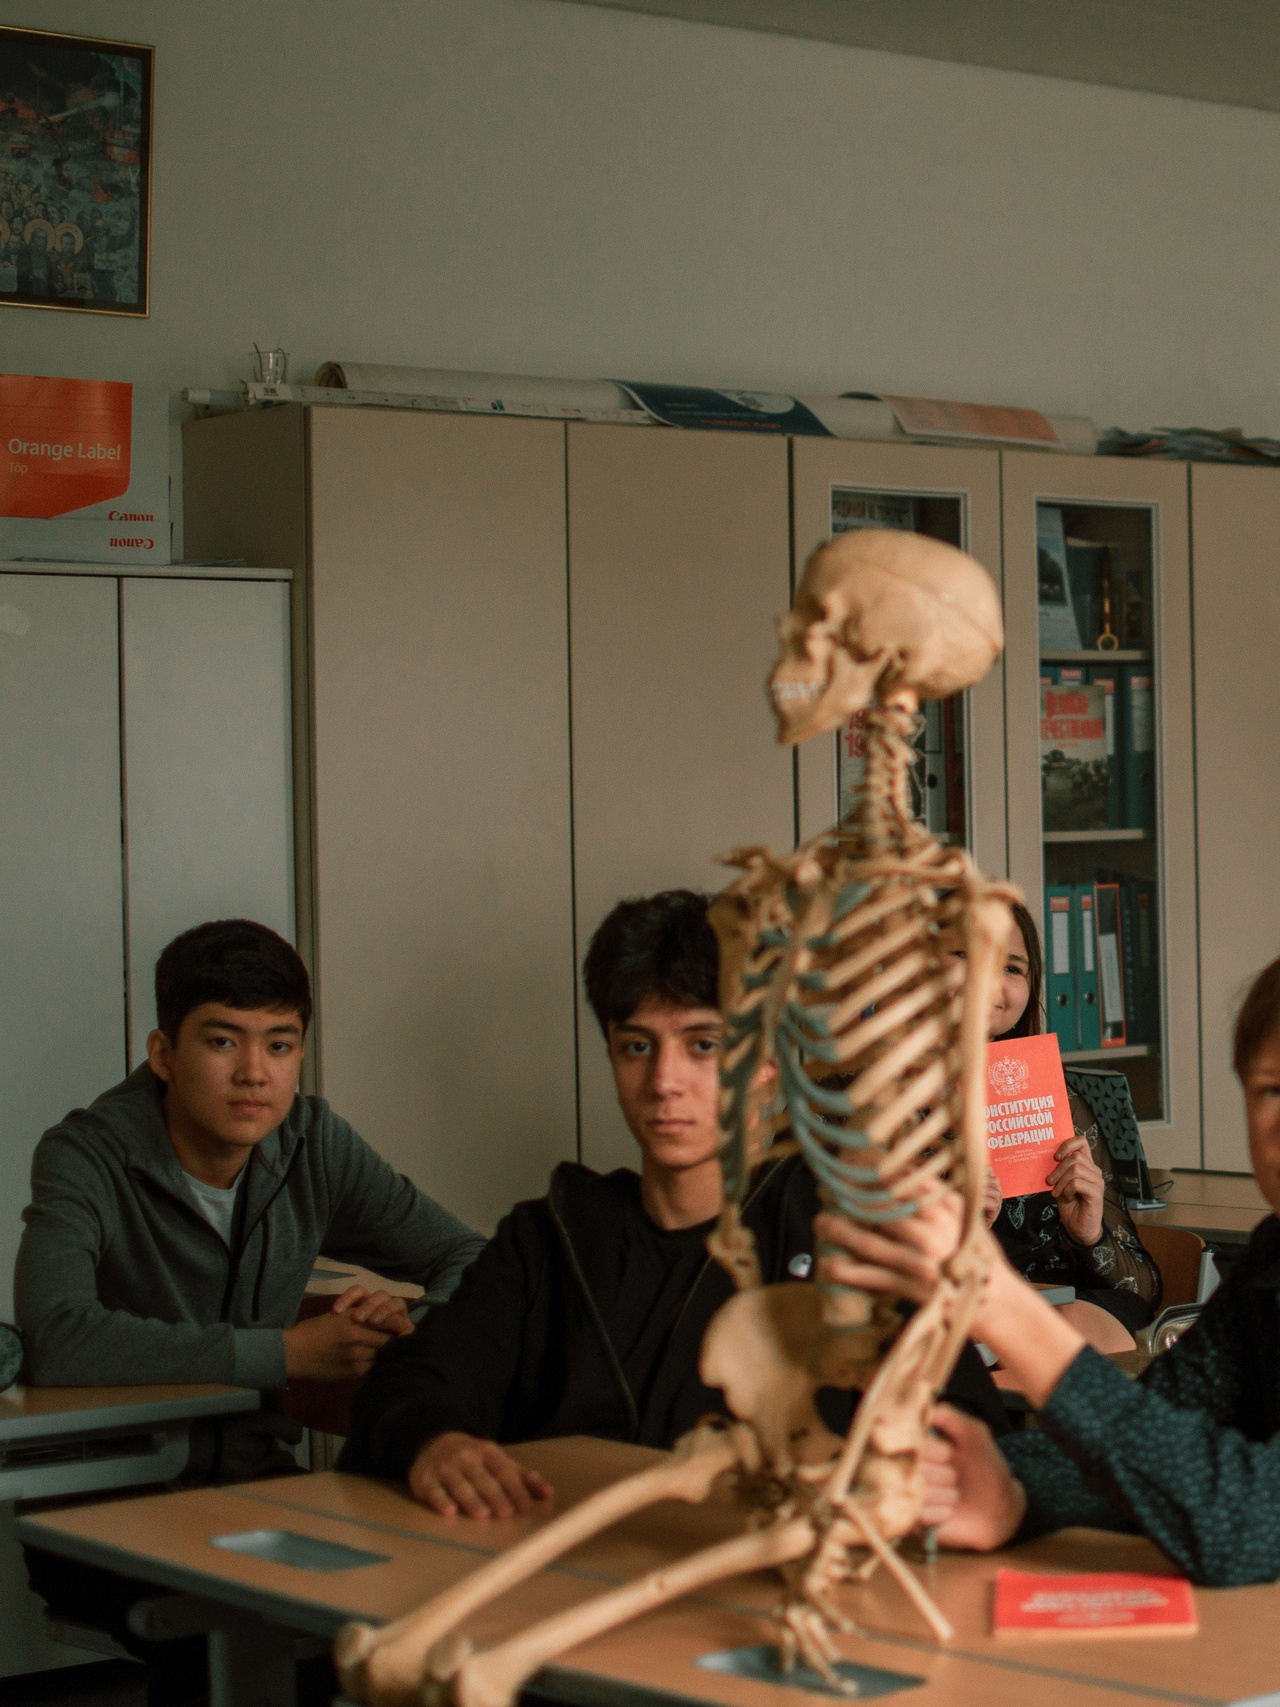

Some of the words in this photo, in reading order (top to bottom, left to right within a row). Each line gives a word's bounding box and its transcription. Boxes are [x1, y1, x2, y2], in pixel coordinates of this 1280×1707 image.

[8, 438, 73, 461] Orange
[78, 443, 121, 460] Label
[9, 462, 28, 475] Top
[108, 511, 154, 521] Canon
[110, 538, 154, 549] Canon
[984, 1095, 1055, 1119] ОНСТИТУЦИЯ
[987, 1127, 1055, 1150] ФЕДЕРАЦИИ
